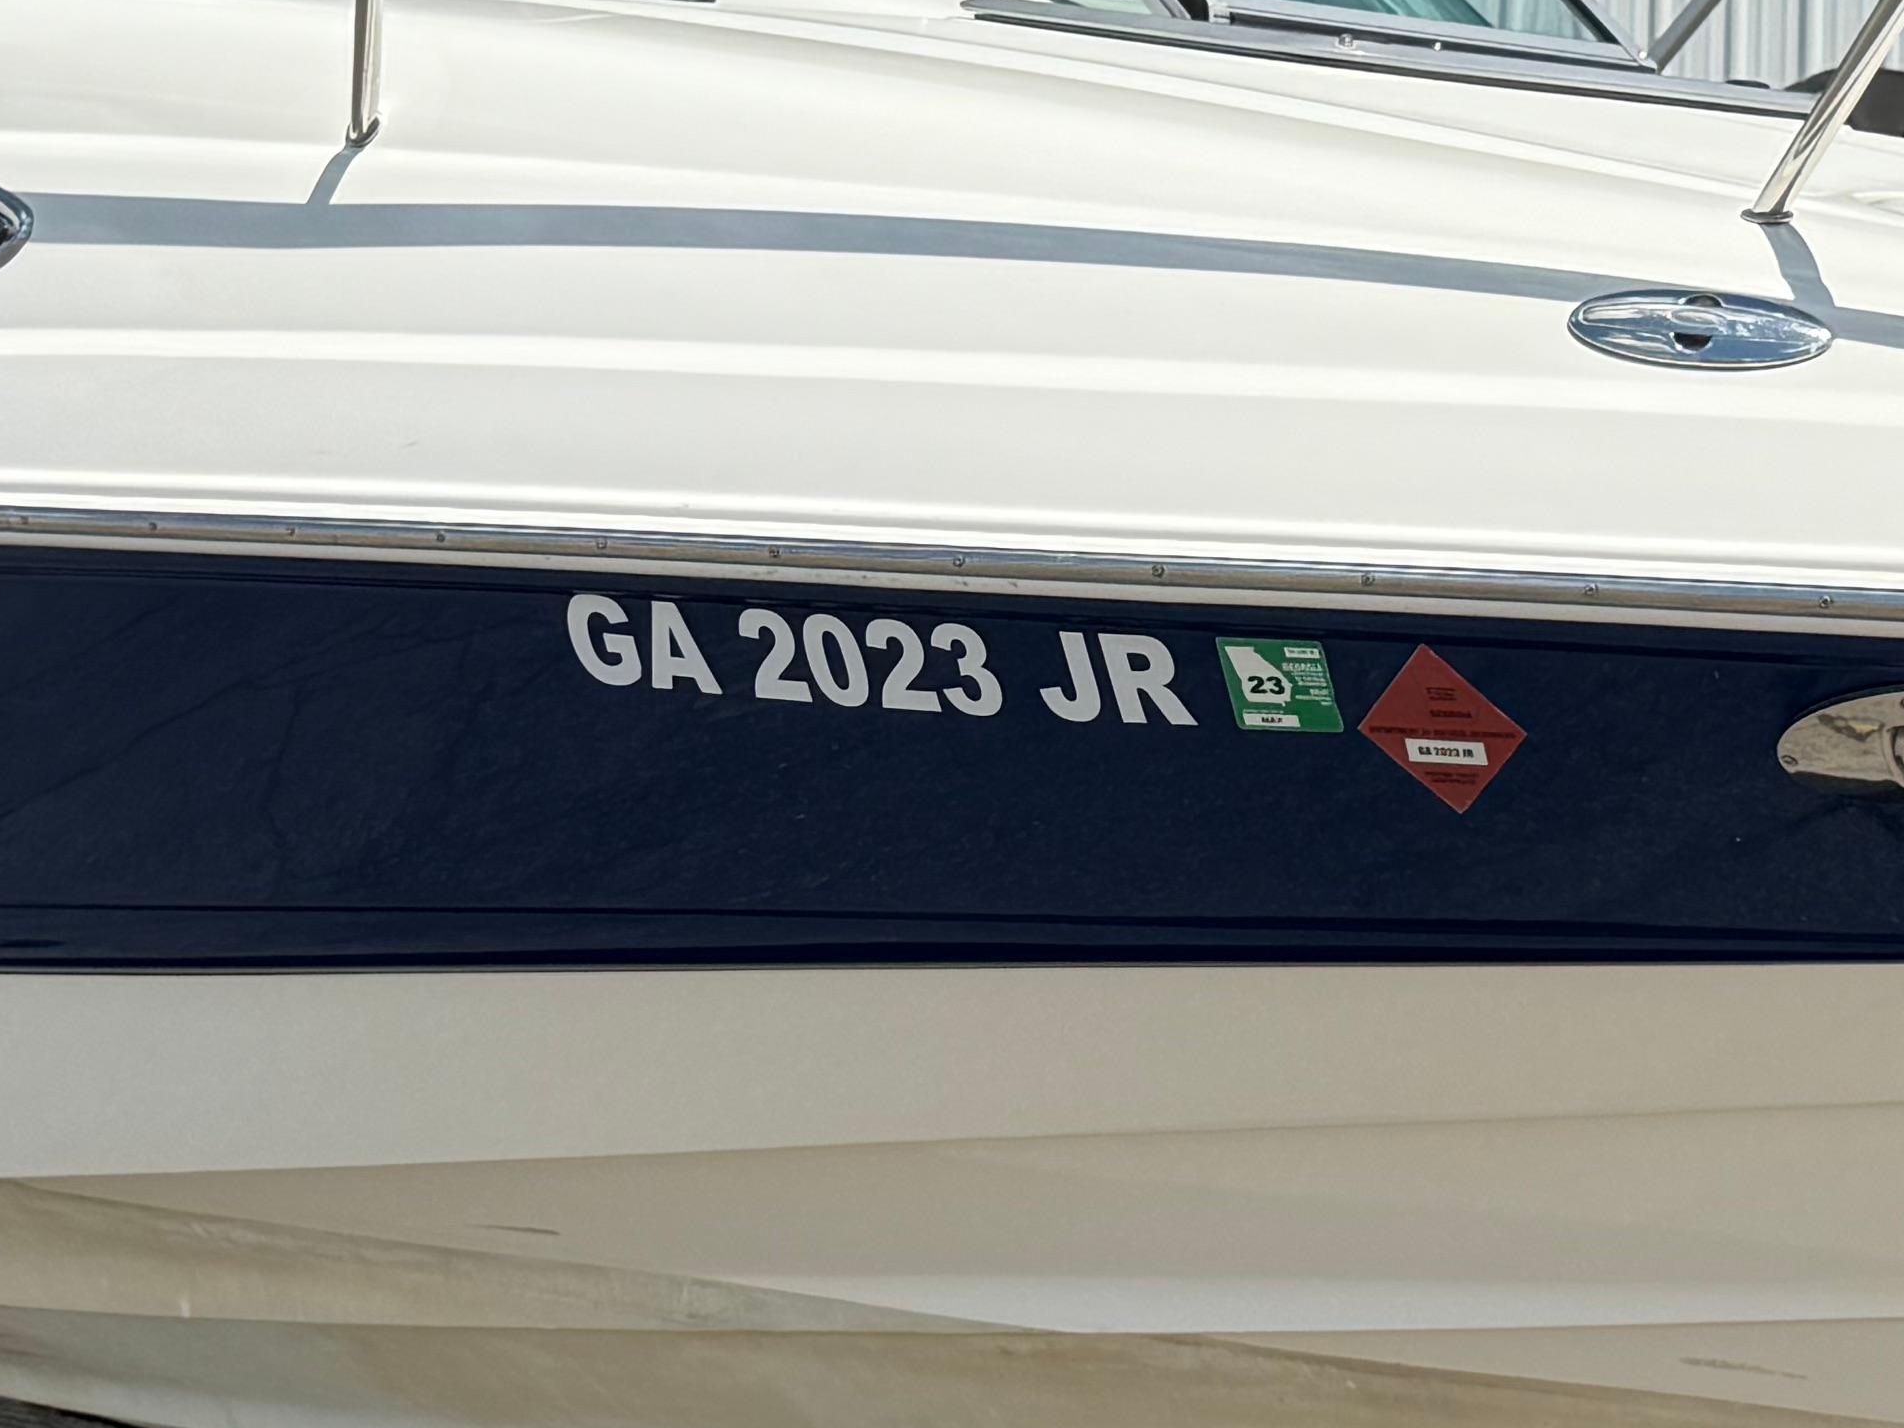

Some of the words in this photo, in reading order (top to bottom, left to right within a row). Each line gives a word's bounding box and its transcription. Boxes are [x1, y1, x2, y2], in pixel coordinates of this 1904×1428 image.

[567, 594, 723, 694] GA
[739, 609, 1003, 716] 2023
[1040, 631, 1198, 726] JR
[1247, 675, 1286, 695] 23
